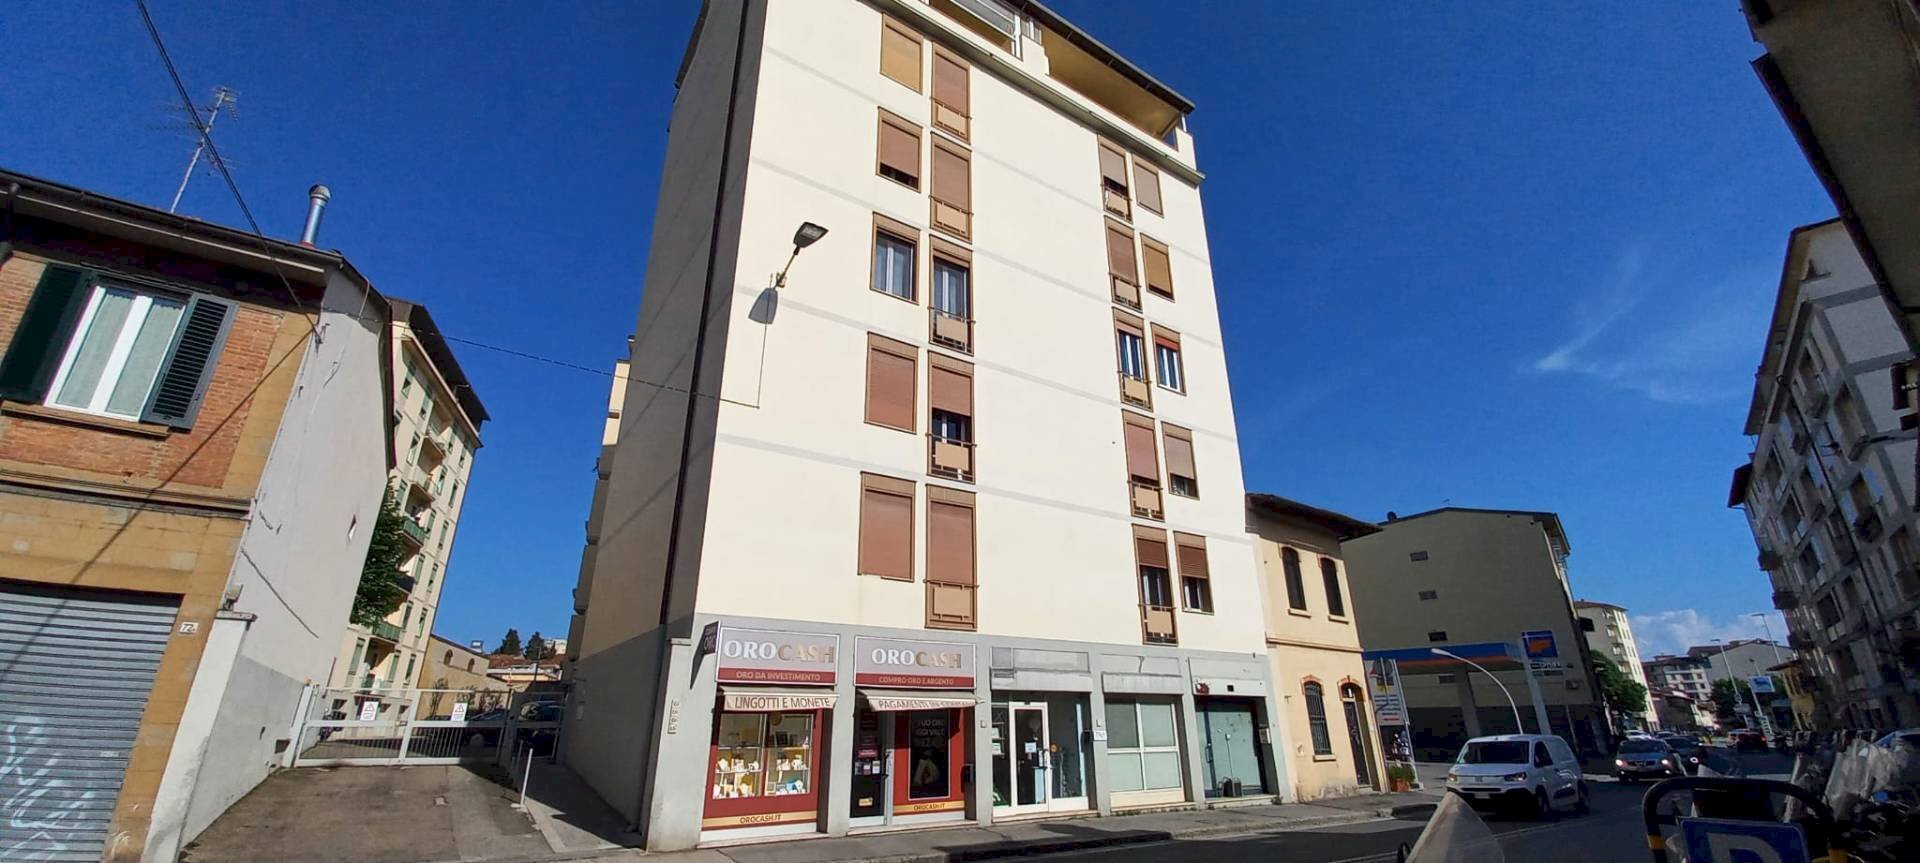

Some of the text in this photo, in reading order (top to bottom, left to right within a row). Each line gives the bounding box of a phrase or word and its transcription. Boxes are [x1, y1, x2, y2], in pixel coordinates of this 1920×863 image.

[724, 640, 835, 664] OROCASH
[871, 648, 962, 669] OROCASH
[736, 671, 821, 681] ORO DA INVESTIMENTO
[879, 676, 906, 684] COMPRO
[734, 696, 831, 709] LINGOTTI E MONETE
[739, 814, 782, 824] OROCASH.IT
